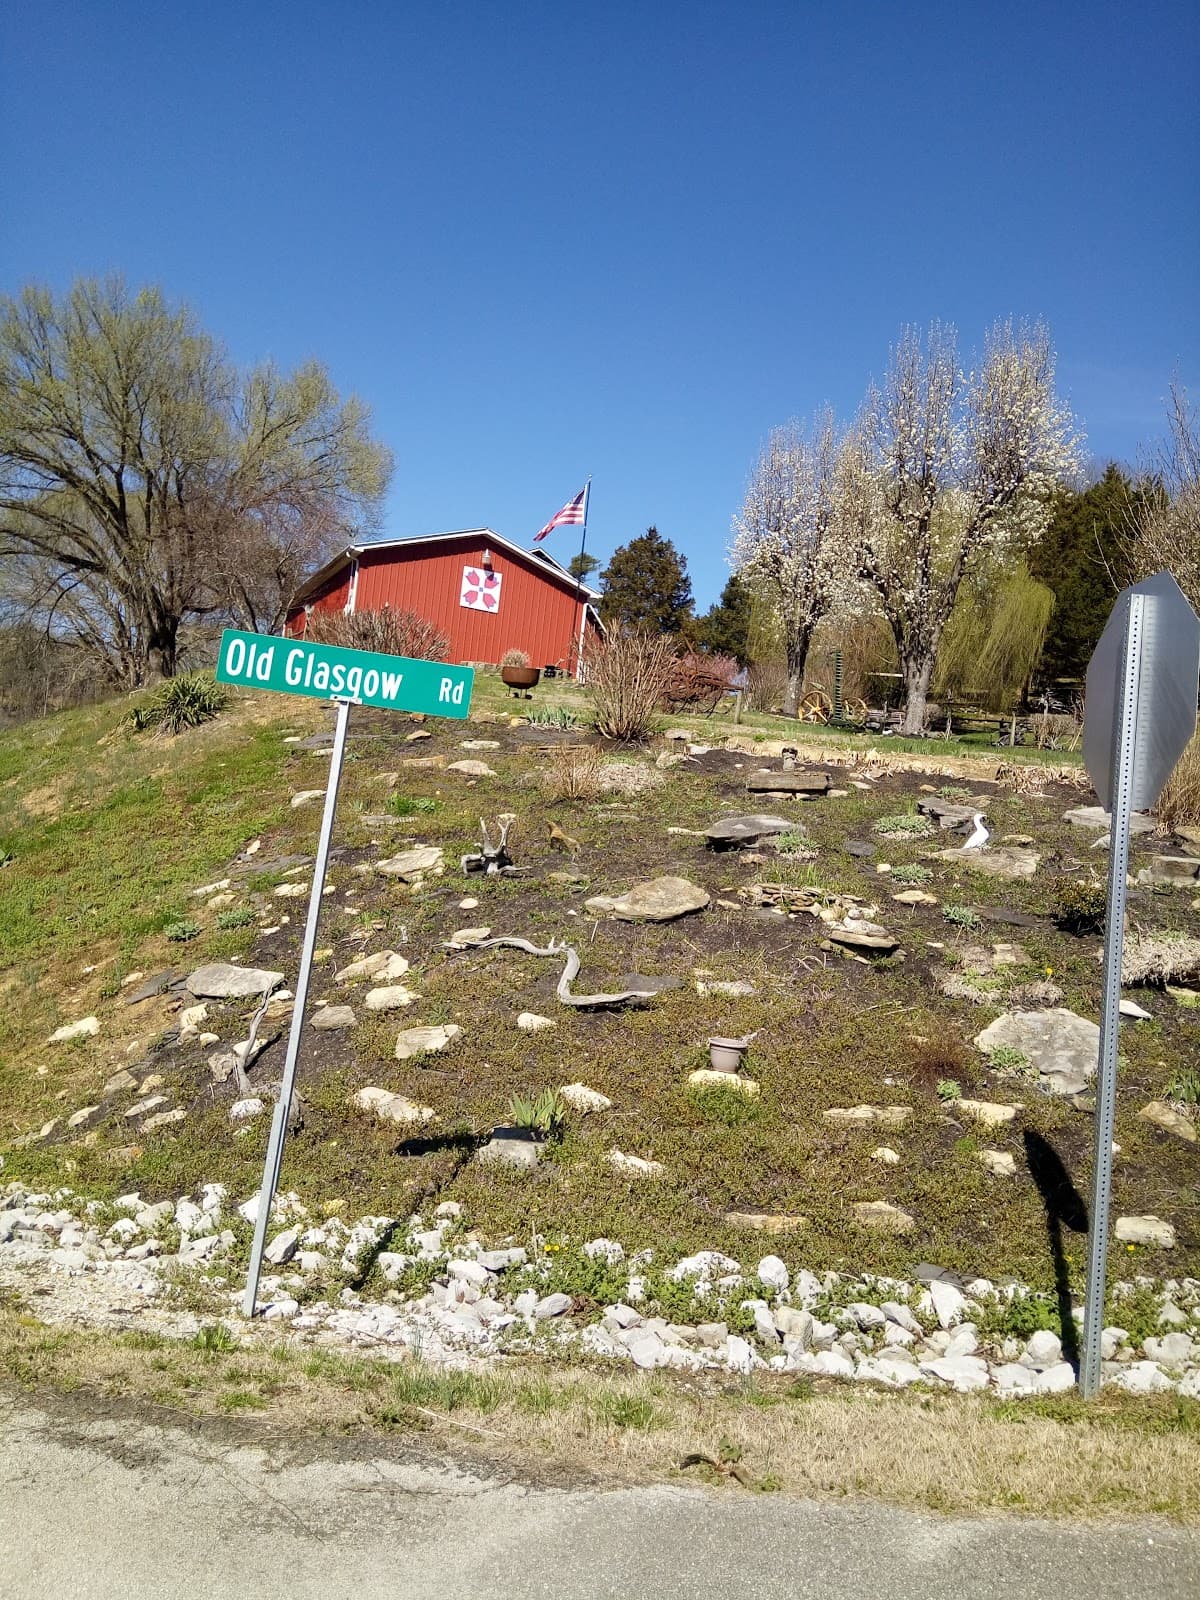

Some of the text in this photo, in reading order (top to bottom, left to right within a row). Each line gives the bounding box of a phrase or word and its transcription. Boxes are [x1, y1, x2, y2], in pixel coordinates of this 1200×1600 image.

[225, 639, 465, 705] Old Glasgow Rd
